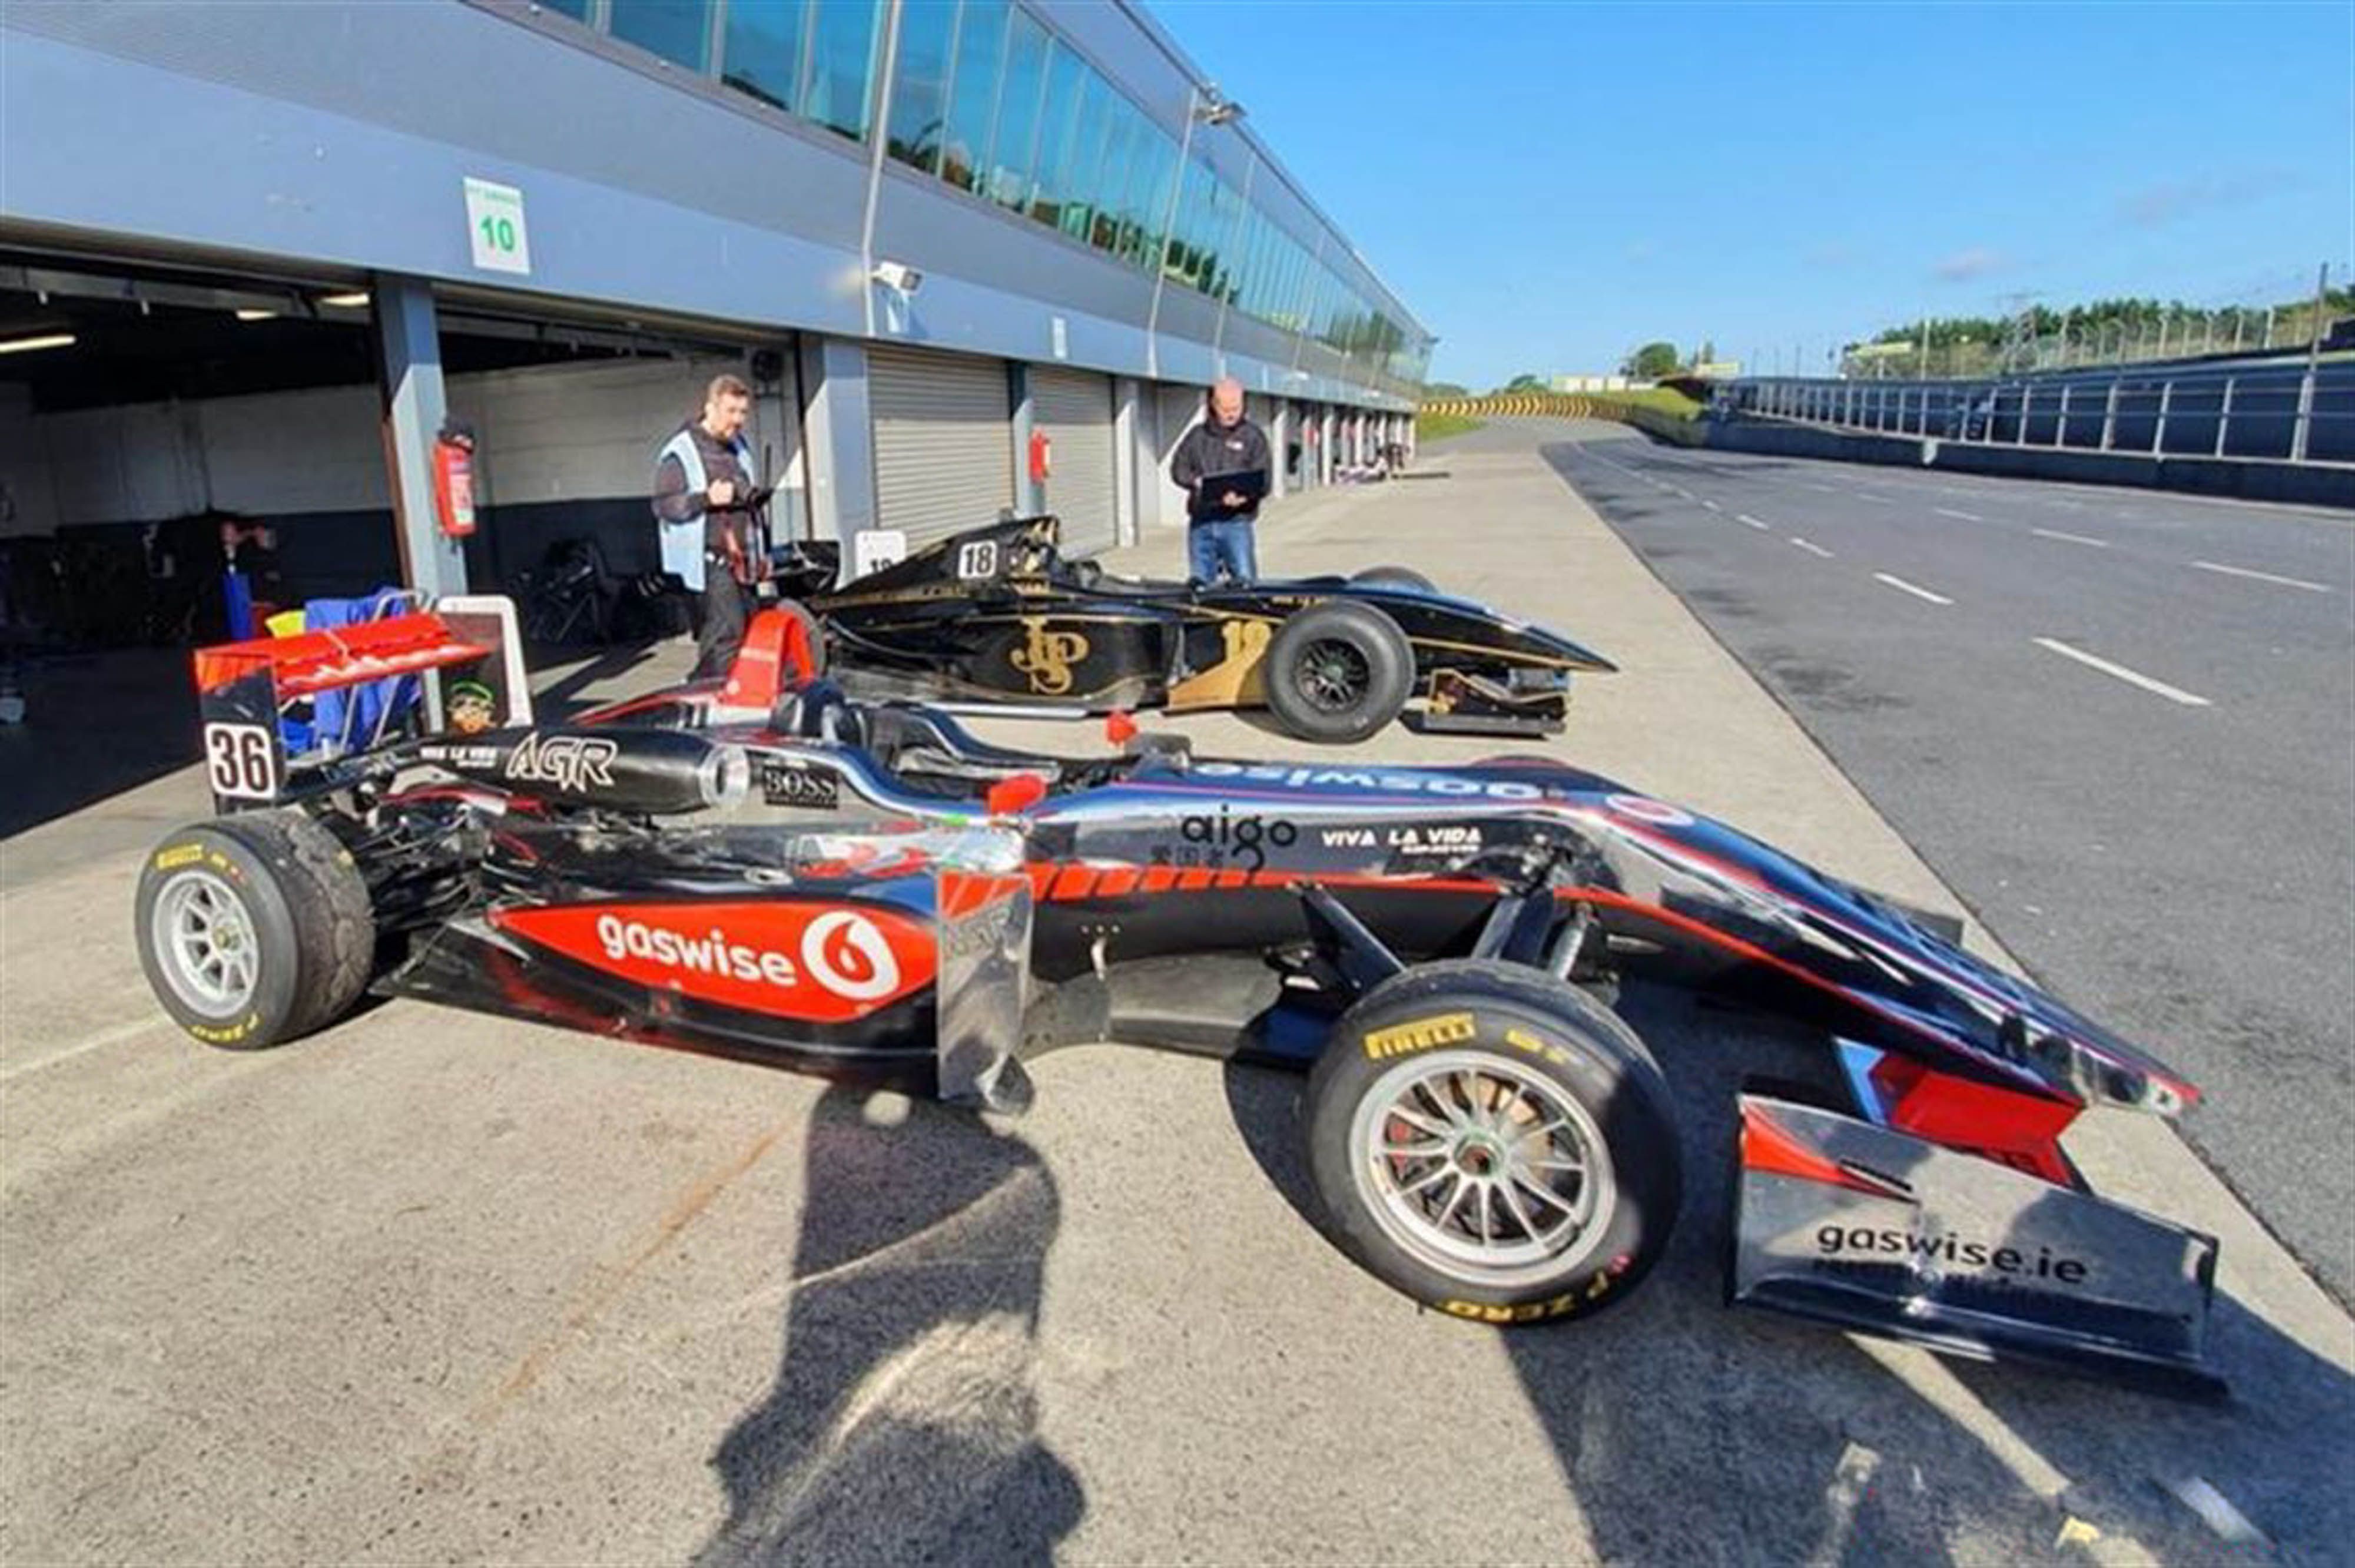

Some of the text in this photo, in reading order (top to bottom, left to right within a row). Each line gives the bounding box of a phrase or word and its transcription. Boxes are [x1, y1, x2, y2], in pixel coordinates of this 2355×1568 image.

[480, 216, 515, 252] 10
[966, 545, 992, 574] 18
[211, 728, 270, 793] 36
[505, 731, 618, 791] AGR
[765, 770, 836, 797] BOSS
[1181, 803, 1297, 876] aigo
[1322, 826, 1481, 847] VIVA LA VIDA
[597, 913, 797, 987] gaswise
[1816, 1224, 2087, 1285] gaswise.ie
